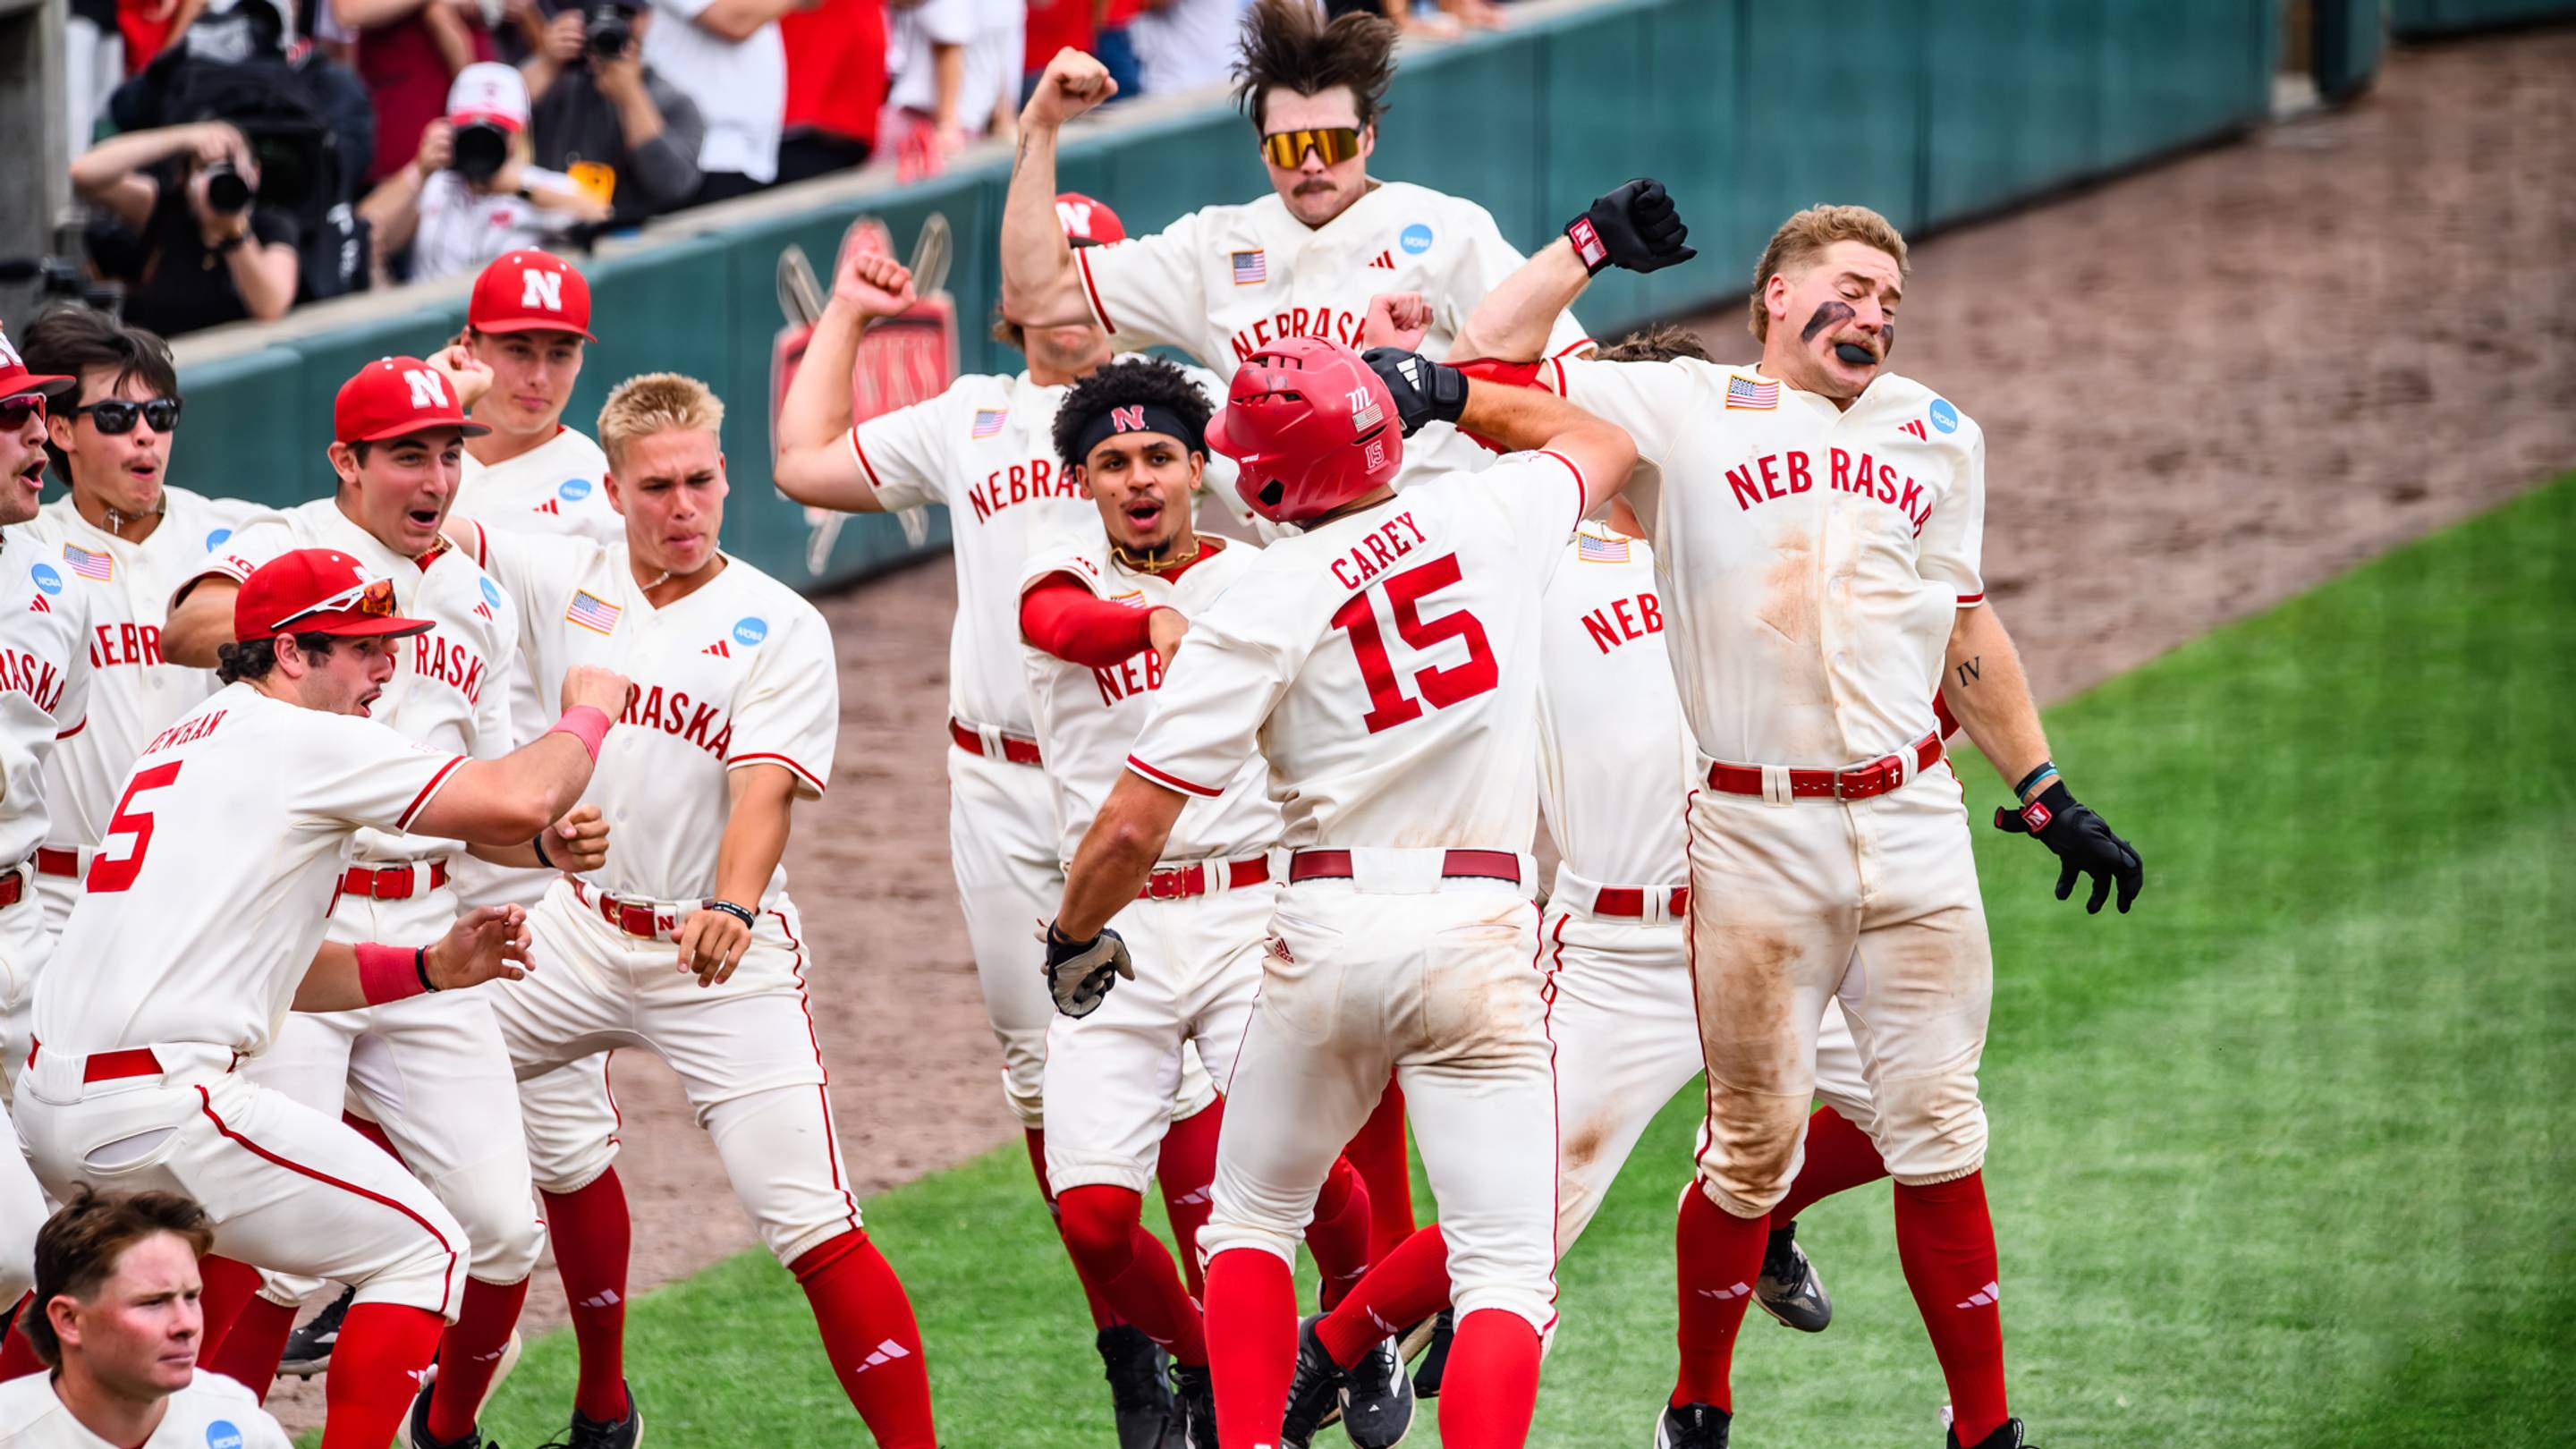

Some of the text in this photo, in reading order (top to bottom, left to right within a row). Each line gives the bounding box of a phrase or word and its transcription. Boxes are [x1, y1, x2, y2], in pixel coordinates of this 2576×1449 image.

[521, 268, 562, 311] N
[403, 369, 449, 409] N
[1111, 404, 1146, 433] N
[1933, 410, 1955, 429] NCAA
[1365, 439, 1385, 470] 15
[1330, 511, 1427, 590] CAREY
[1330, 551, 1499, 735] 15
[1580, 592, 1664, 656] NEB
[1956, 657, 1981, 688] IV
[86, 759, 183, 894] 5
[657, 915, 674, 931] N
